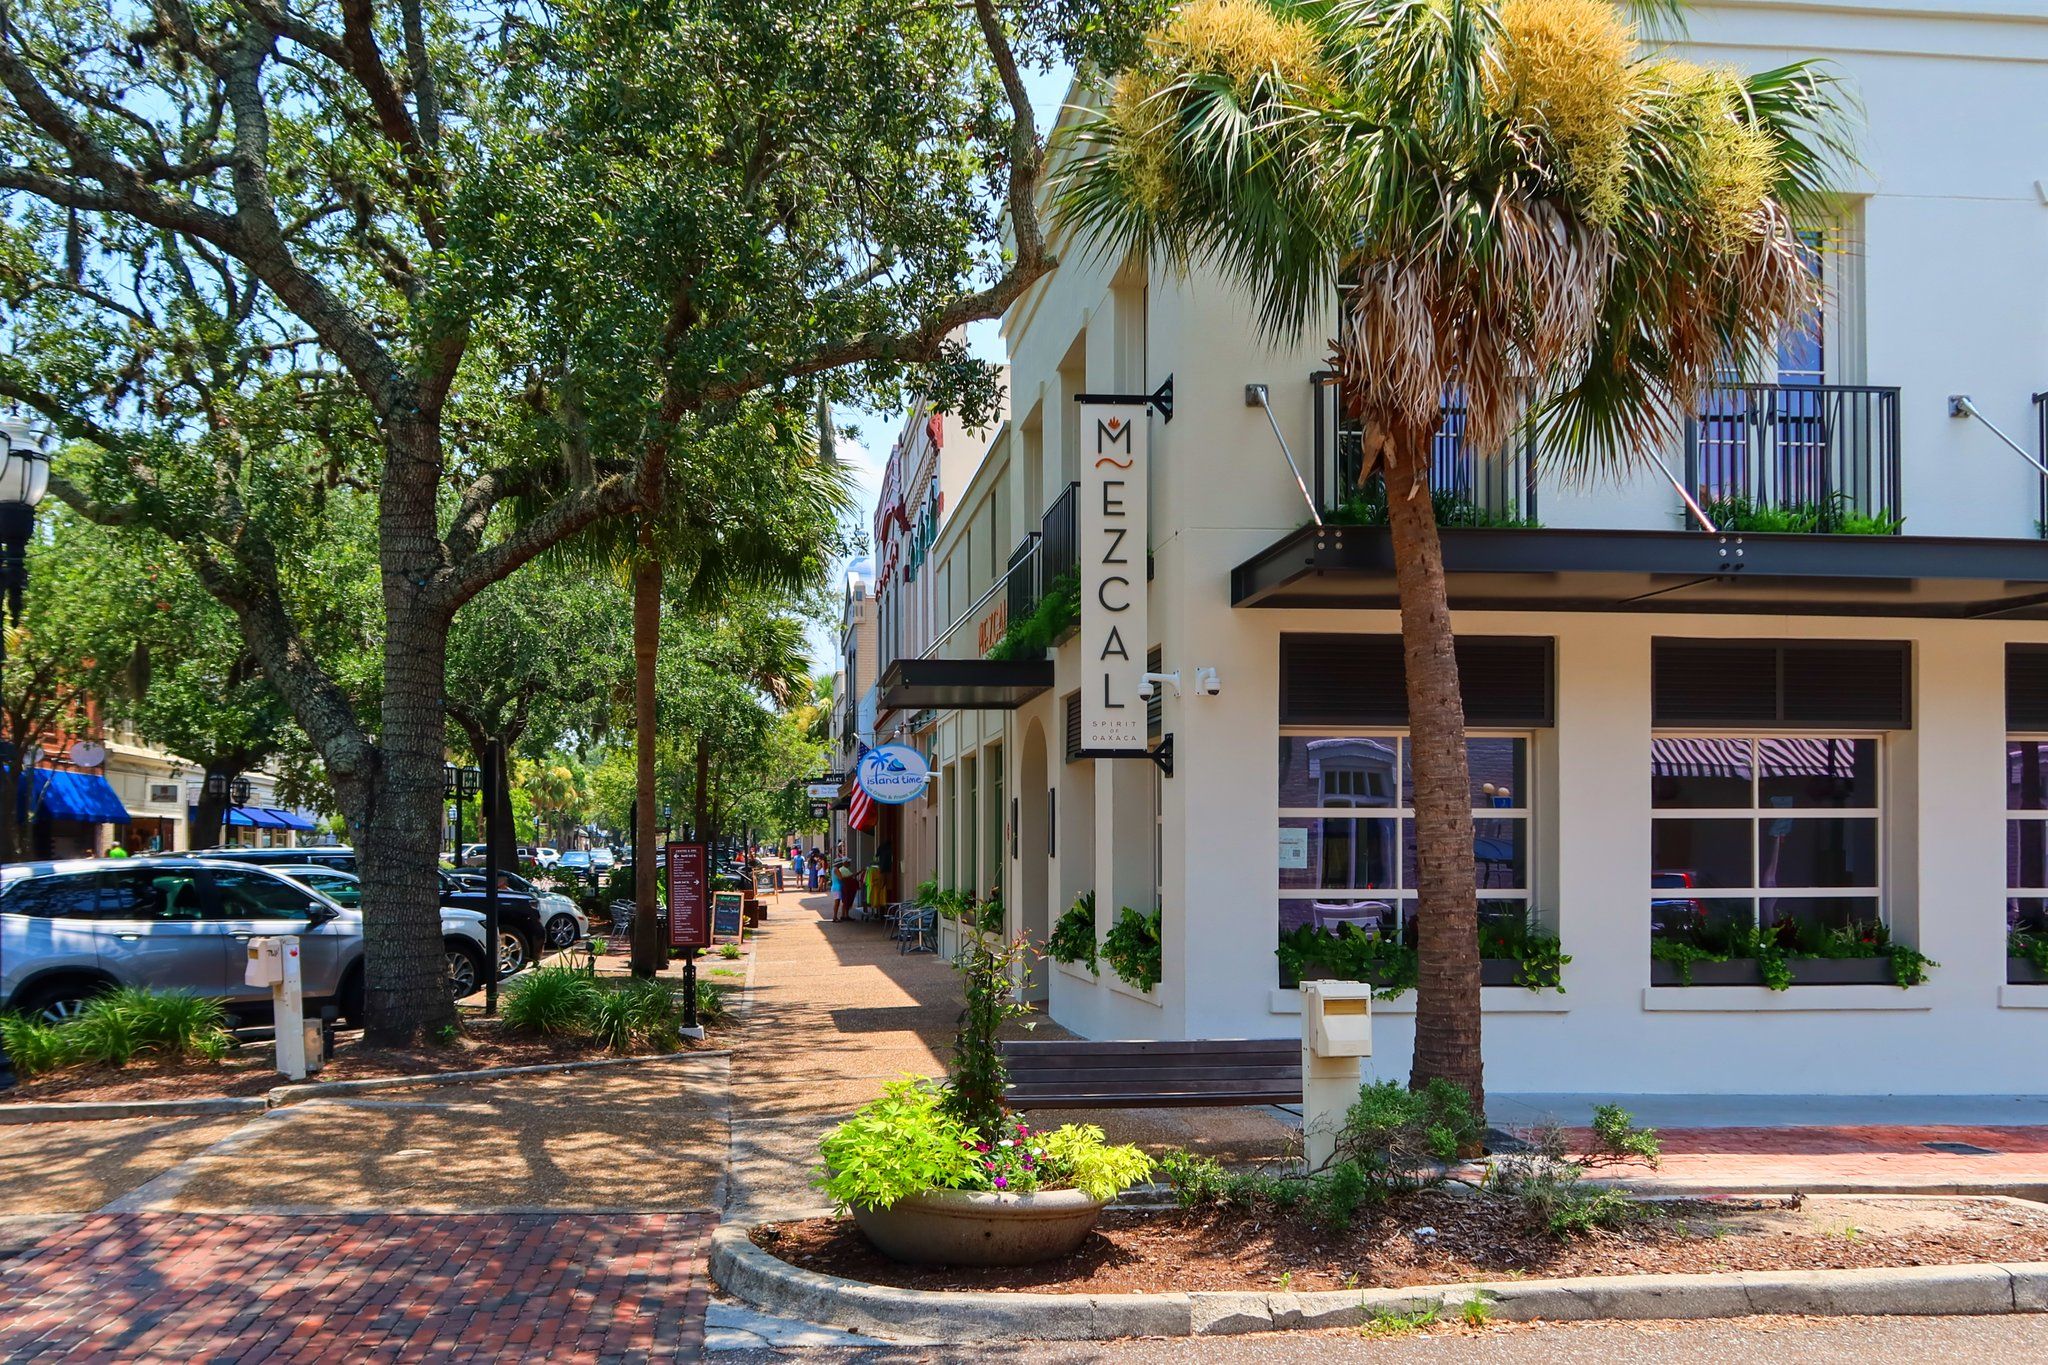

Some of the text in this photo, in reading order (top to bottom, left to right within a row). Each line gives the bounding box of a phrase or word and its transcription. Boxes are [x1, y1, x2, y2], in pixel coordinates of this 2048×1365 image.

[1097, 418, 1132, 709] MEZCAL
[866, 775, 922, 785] island time
